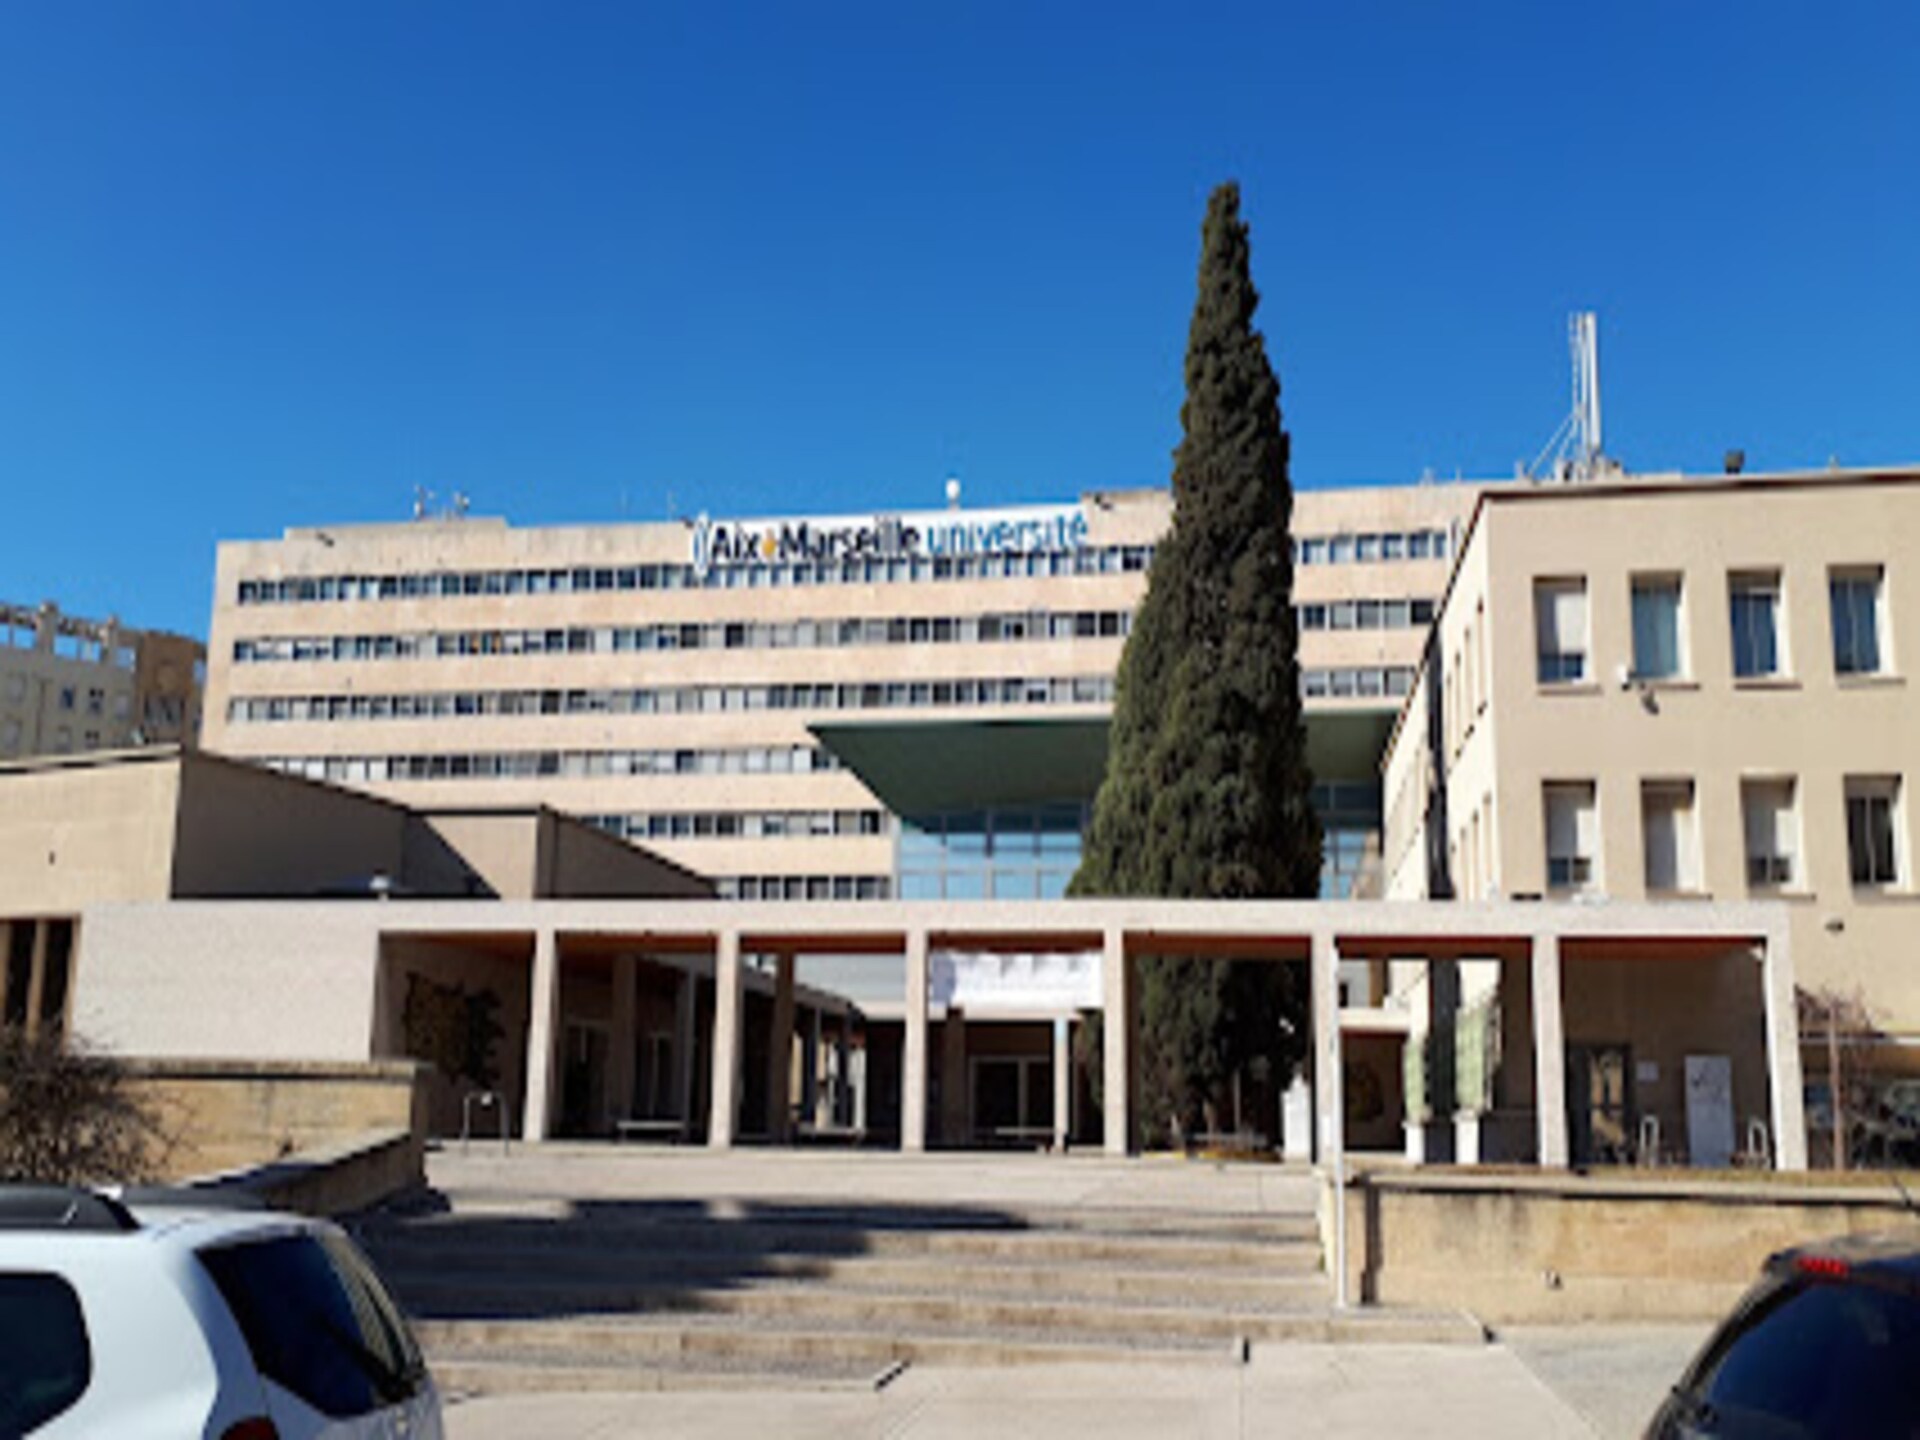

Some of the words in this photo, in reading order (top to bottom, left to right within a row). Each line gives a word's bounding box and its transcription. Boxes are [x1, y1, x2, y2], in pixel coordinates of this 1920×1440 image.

[711, 524, 758, 560] Aix
[777, 515, 921, 559] Marseille
[927, 510, 1089, 552] université
